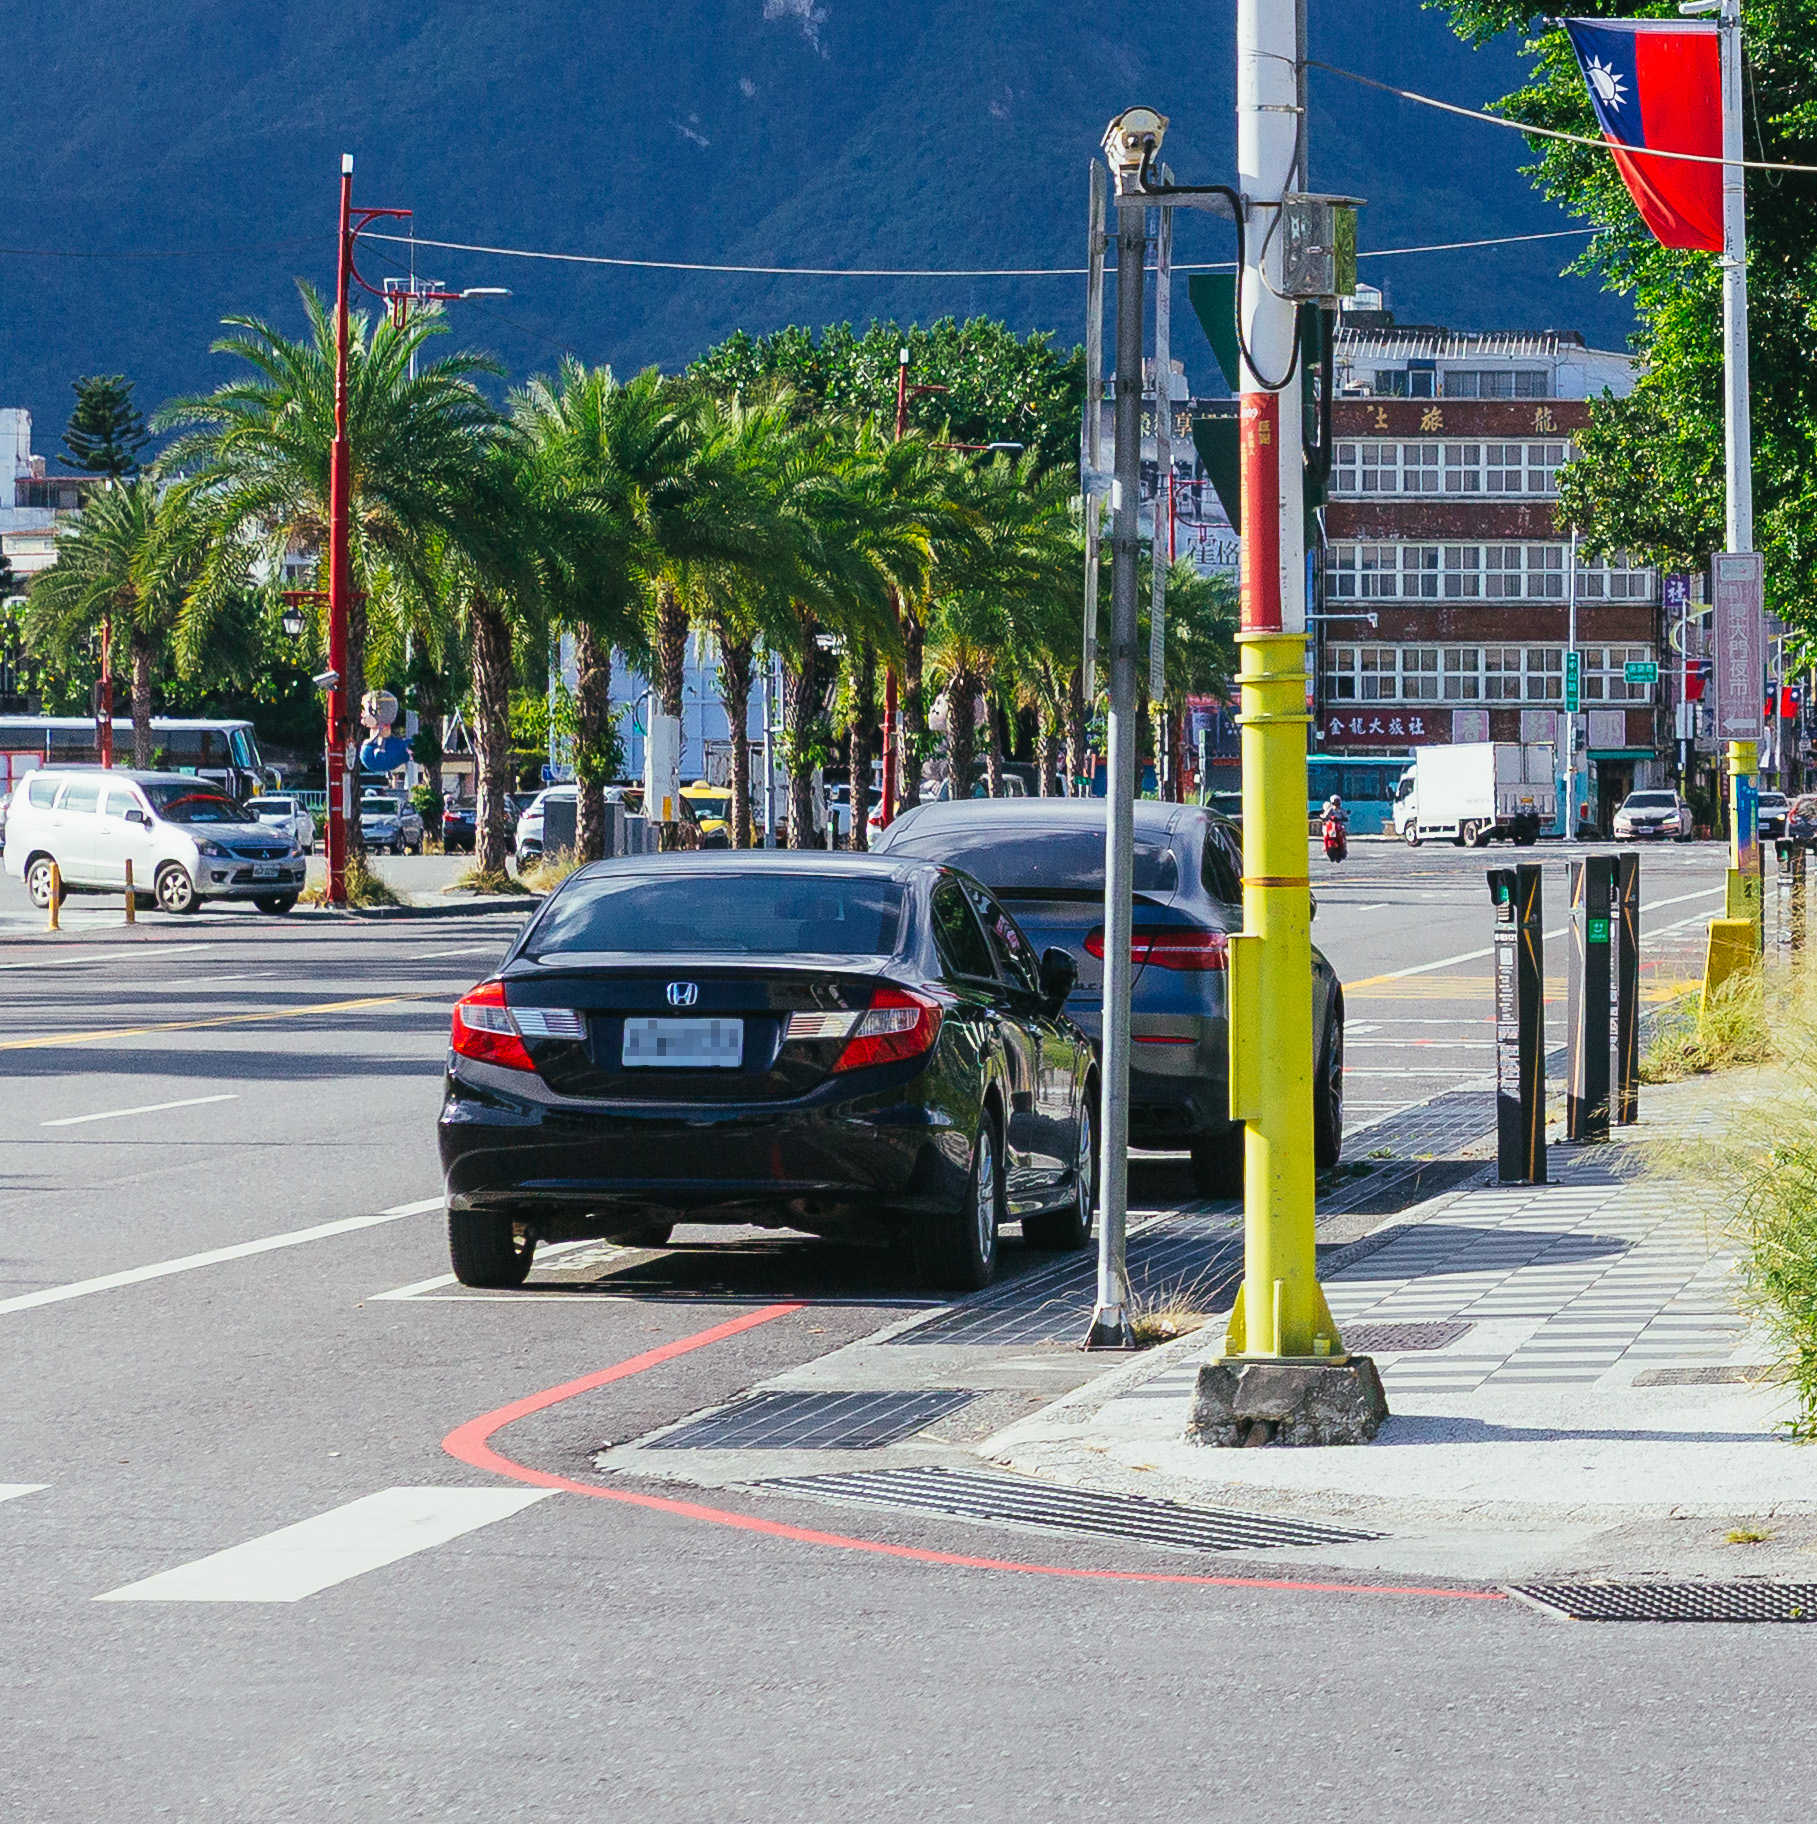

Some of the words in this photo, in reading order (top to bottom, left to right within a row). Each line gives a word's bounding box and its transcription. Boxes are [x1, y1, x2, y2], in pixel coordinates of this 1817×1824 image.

[1729, 603, 1750, 697] 東大門夜市
[1329, 716, 1426, 737] 金龍大旅社
